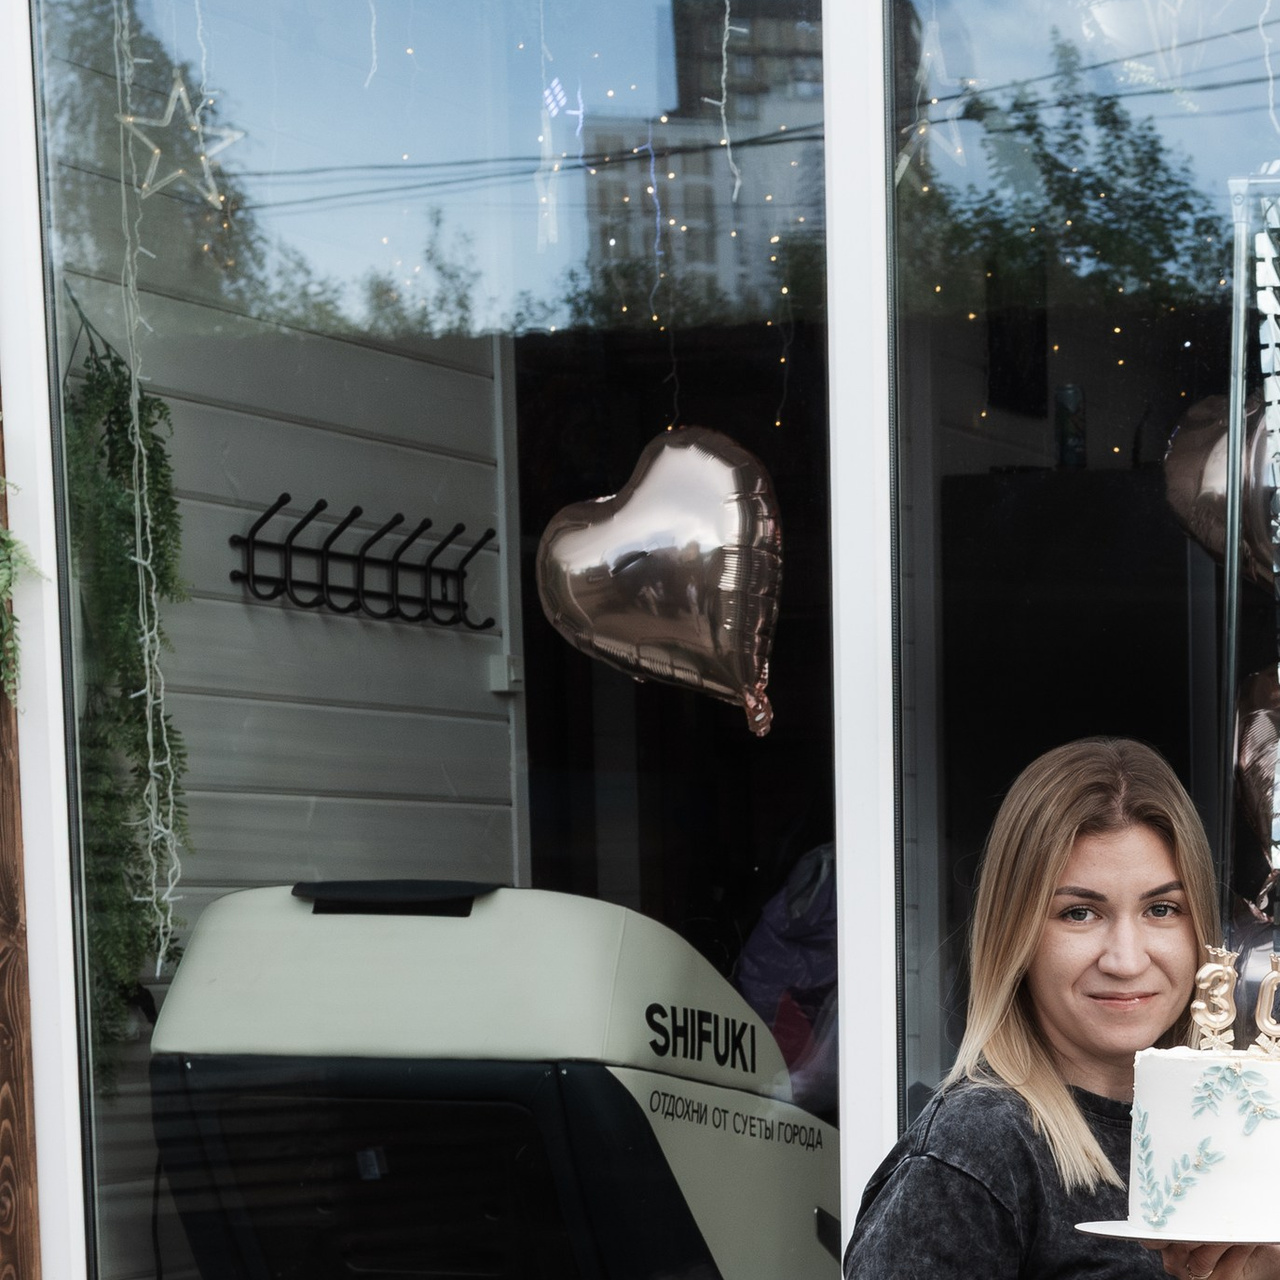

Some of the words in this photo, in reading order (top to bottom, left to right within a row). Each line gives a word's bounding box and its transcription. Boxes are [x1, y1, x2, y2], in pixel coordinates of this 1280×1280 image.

[645, 1002, 756, 1074] SHIFUKI
[650, 1090, 708, 1125] ОТДОХНИ
[712, 1107, 729, 1131] ОТ
[733, 1112, 774, 1141] СУЕТЫ
[778, 1121, 823, 1152] ГОРОДА
